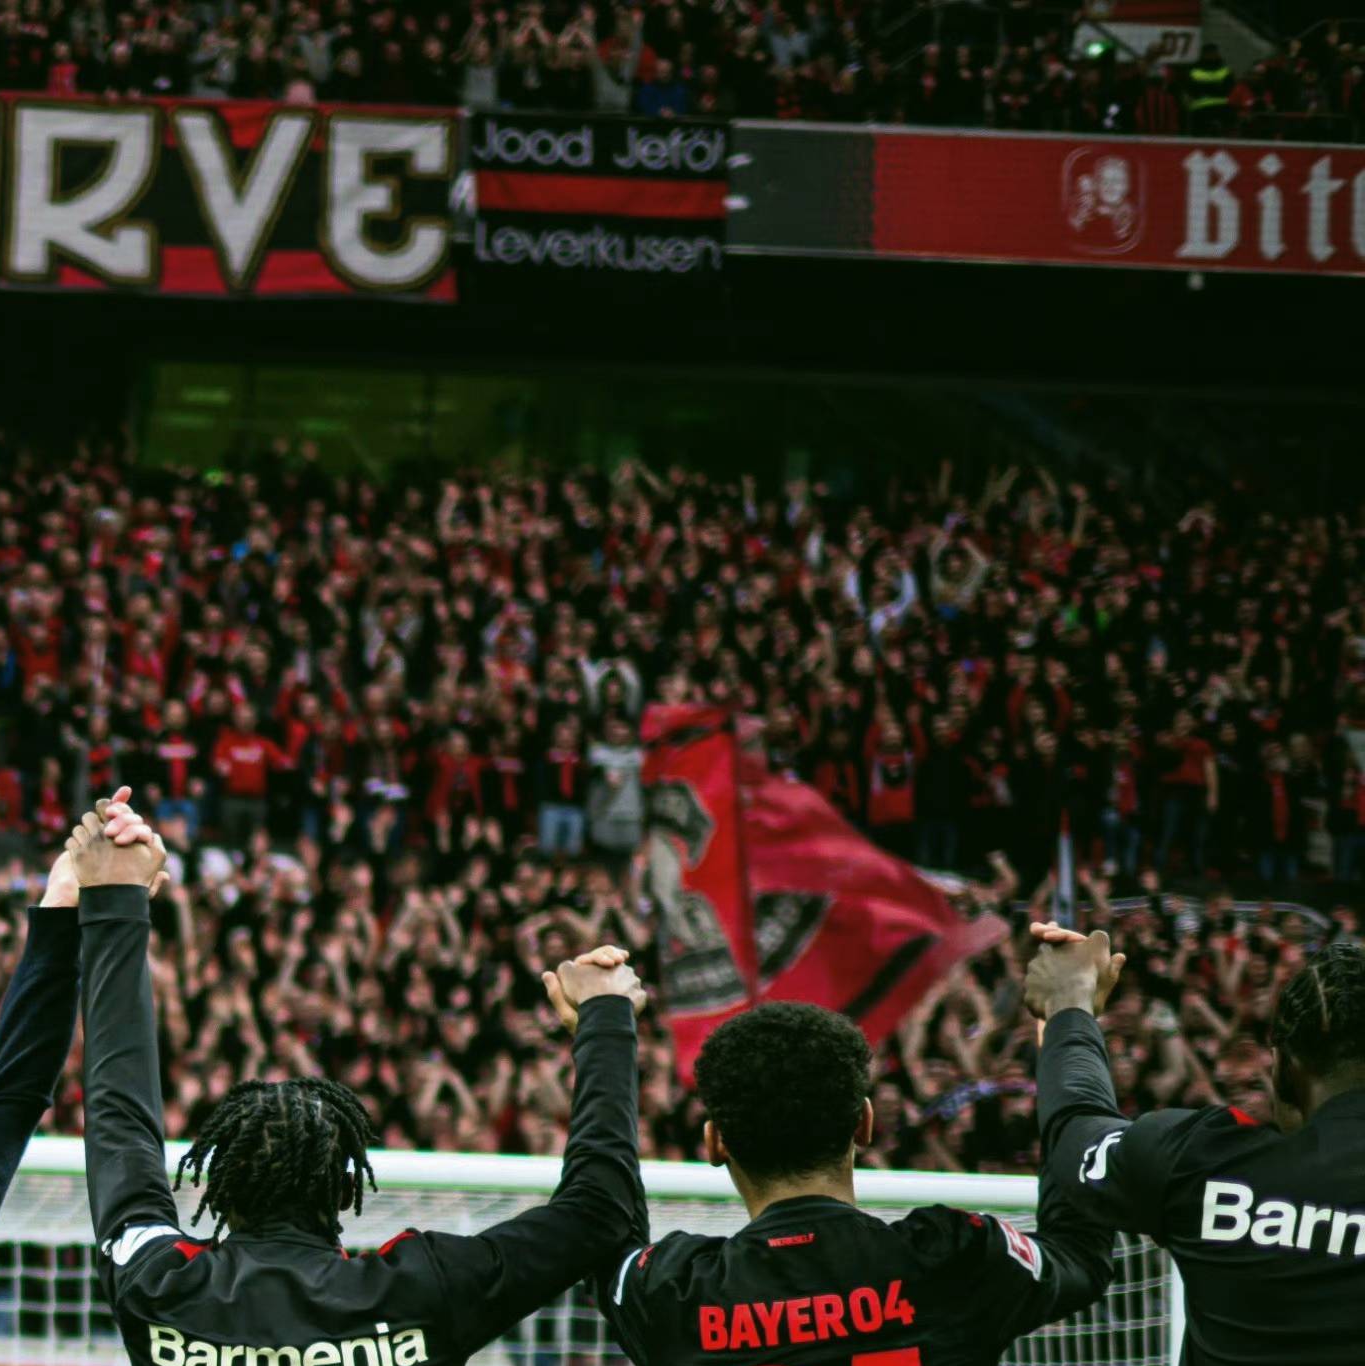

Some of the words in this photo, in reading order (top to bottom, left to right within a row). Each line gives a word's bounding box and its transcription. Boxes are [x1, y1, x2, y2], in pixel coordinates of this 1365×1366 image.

[472, 118, 594, 168] Jood
[1176, 148, 1365, 264] Bit
[474, 221, 723, 273] Leverkusen
